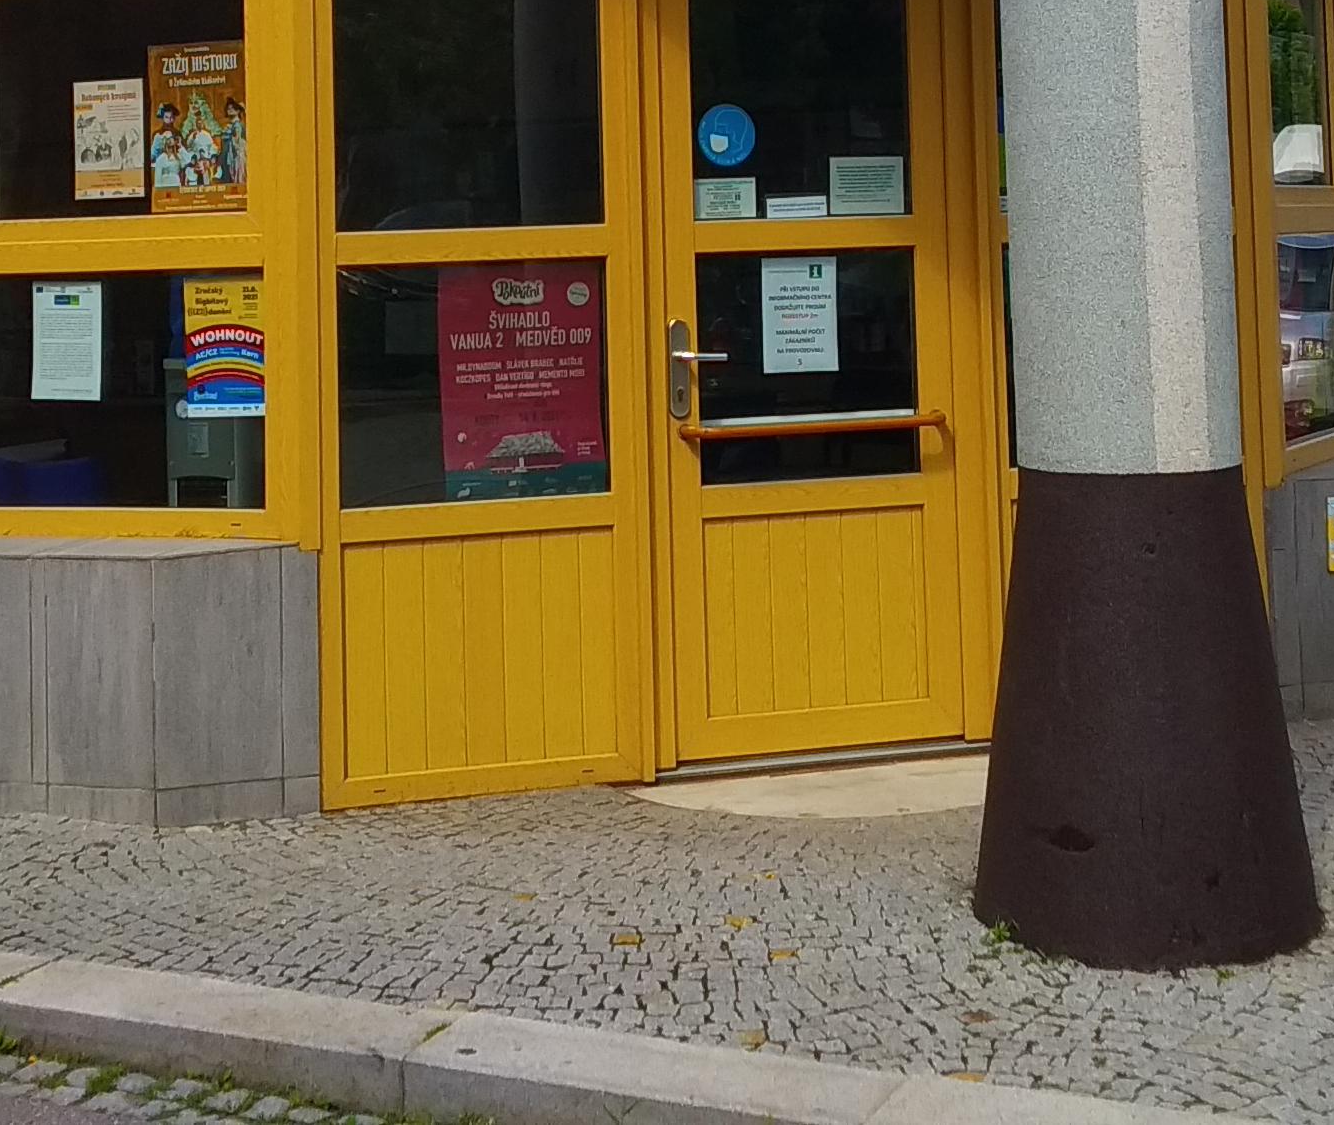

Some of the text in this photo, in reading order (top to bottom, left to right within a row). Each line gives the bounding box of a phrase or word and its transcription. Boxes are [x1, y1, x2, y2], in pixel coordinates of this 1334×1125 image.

[488, 310, 551, 330] ŠVIHADLO
[190, 329, 264, 347] WOHNOUT
[450, 326, 592, 350] VANUA 2 MEDVĚD 009
